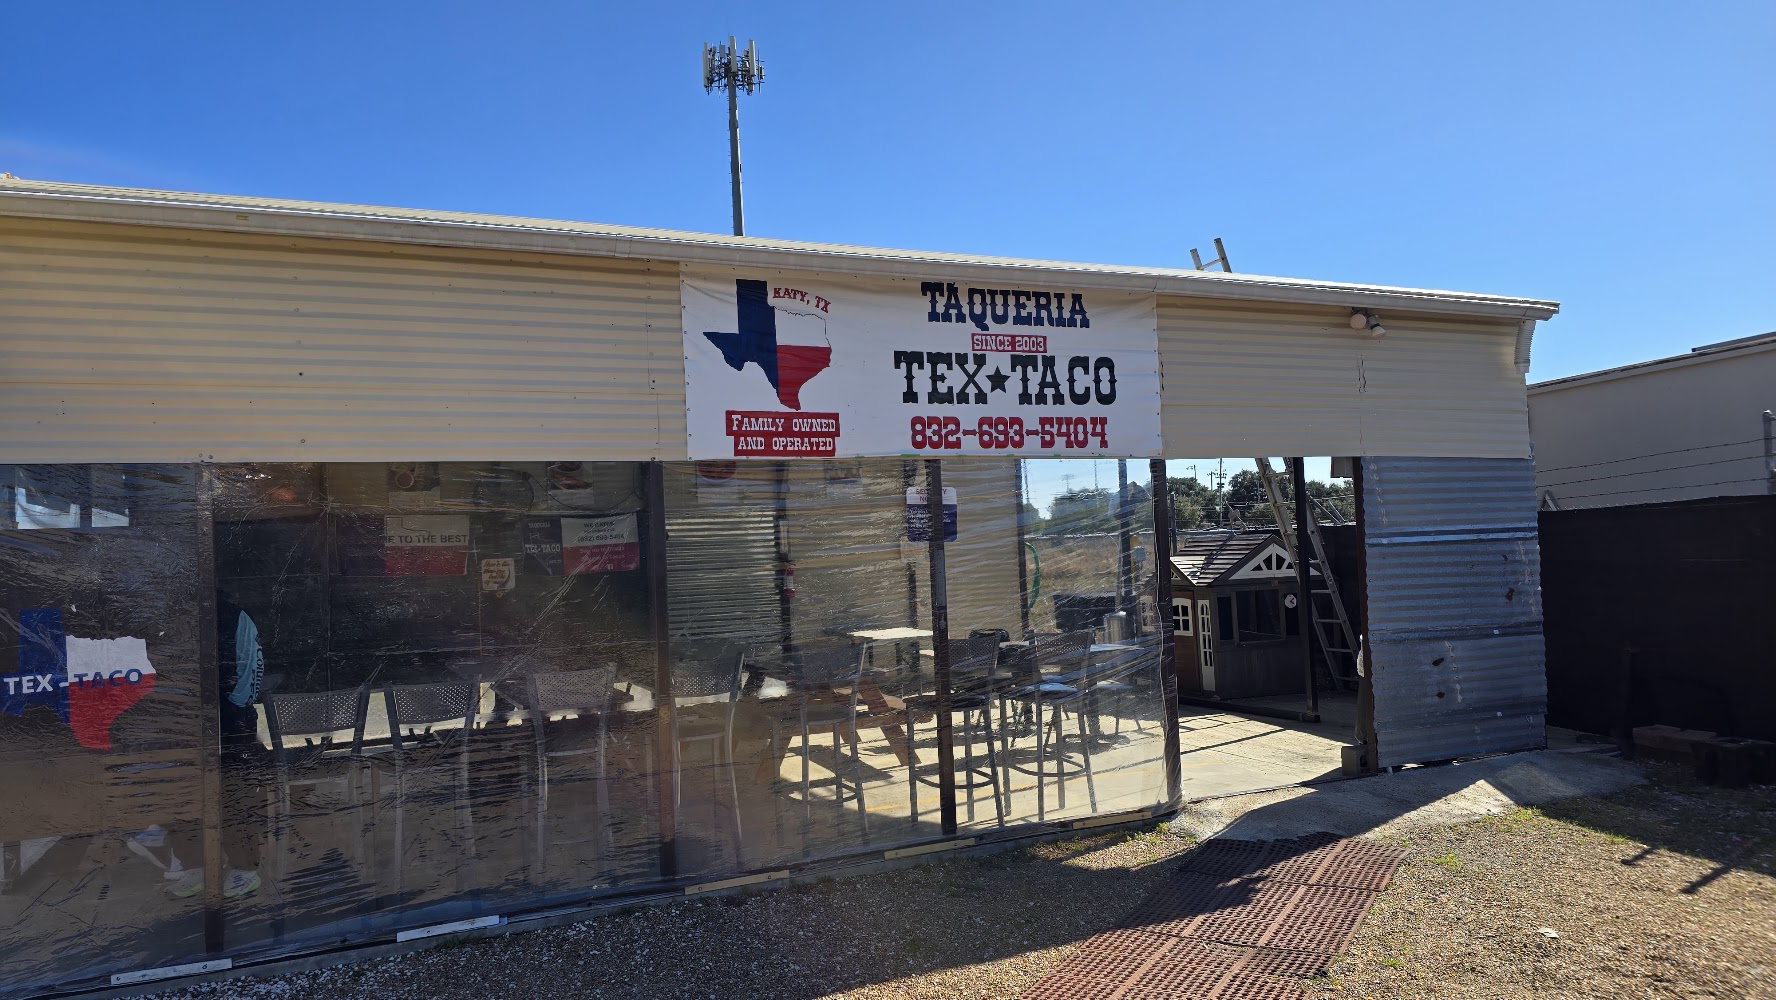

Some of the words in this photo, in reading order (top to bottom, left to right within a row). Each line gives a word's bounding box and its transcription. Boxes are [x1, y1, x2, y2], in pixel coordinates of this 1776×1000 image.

[773, 287, 810, 306] KATY,
[814, 295, 832, 314] TX
[921, 281, 1090, 330] TAQUERIA
[973, 335, 1013, 351] SINCE
[1015, 336, 1045, 352] 2003
[894, 350, 988, 405] TEX
[1010, 354, 1117, 406] TACO
[732, 414, 785, 432] FAMILY
[792, 418, 836, 432] OWNED
[910, 415, 1108, 450] 832-693-5404
[737, 436, 765, 450] AND
[772, 437, 833, 451] OPERATED
[398, 534, 413, 544] TO
[415, 534, 437, 544] THE
[440, 533, 468, 543] BEST
